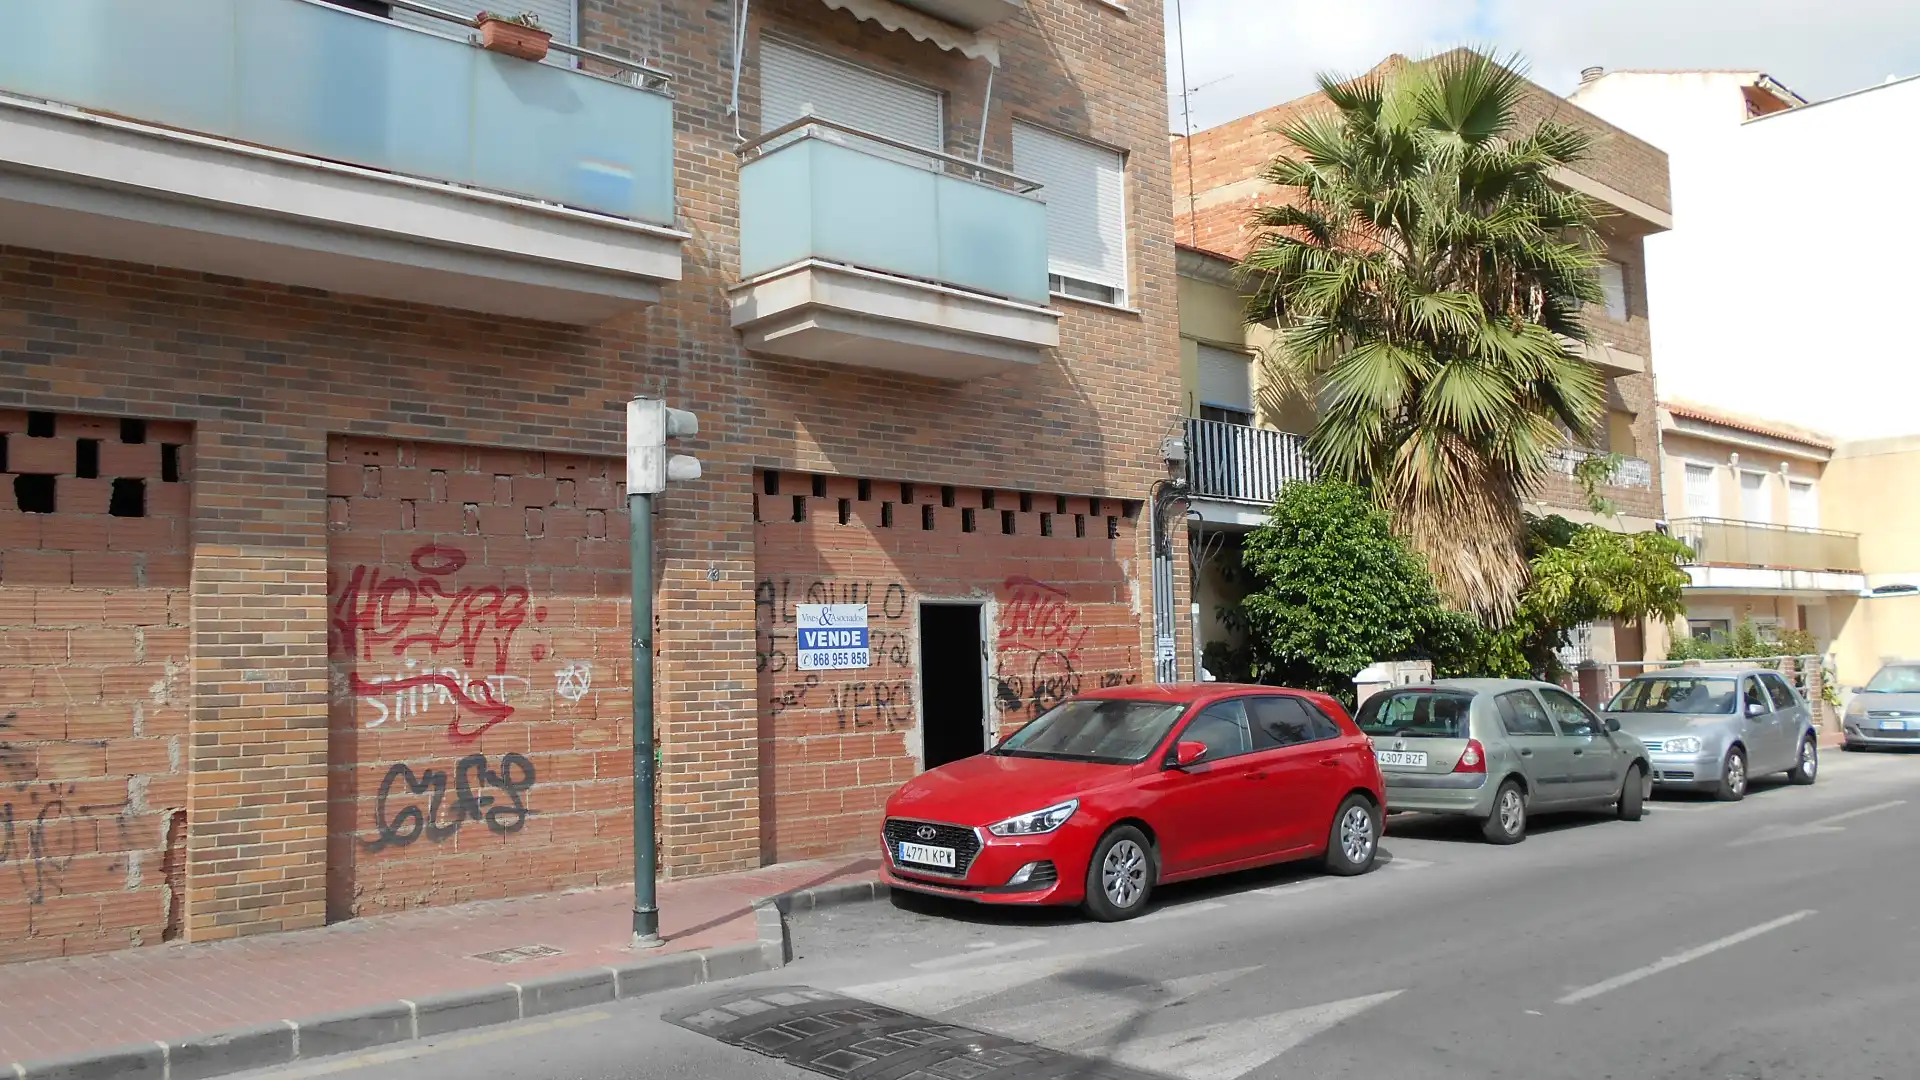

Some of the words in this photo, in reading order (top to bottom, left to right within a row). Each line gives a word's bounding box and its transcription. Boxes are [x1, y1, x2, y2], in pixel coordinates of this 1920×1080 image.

[819, 607, 833, 626] &
[831, 613, 864, 621] Asociados
[805, 631, 861, 647] VENDE
[813, 653, 830, 666] 868
[832, 652, 849, 666] 955
[851, 652, 867, 665] 858
[1380, 753, 1403, 763] 4307
[1405, 754, 1424, 764] BZF
[906, 846, 929, 861] 4771
